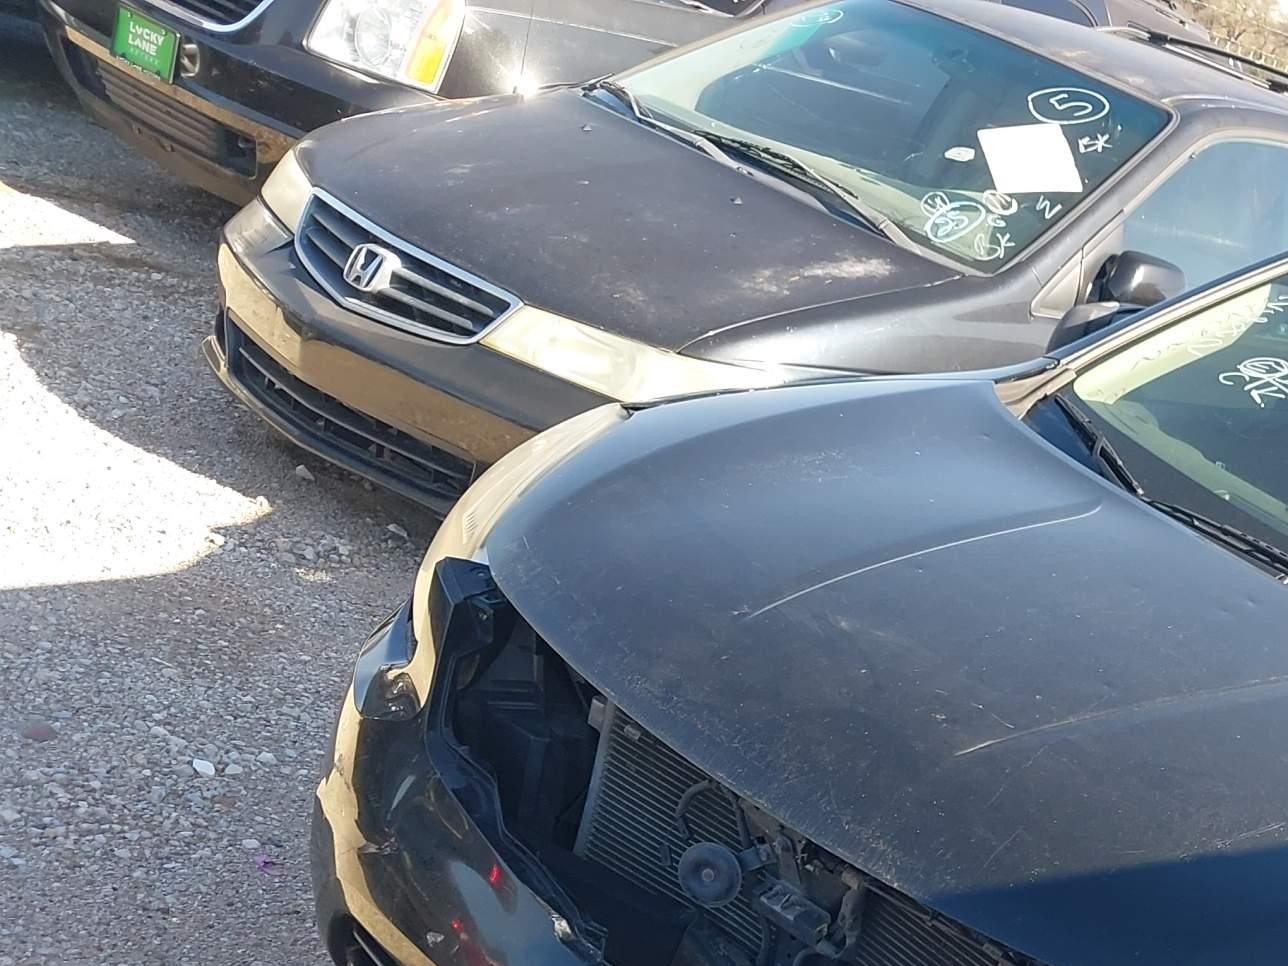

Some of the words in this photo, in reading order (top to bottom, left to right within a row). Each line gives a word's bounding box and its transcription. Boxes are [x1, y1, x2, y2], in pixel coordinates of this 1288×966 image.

[127, 33, 158, 56] LANE
[129, 21, 165, 46] LUCKY
[1049, 93, 1093, 117] 5
